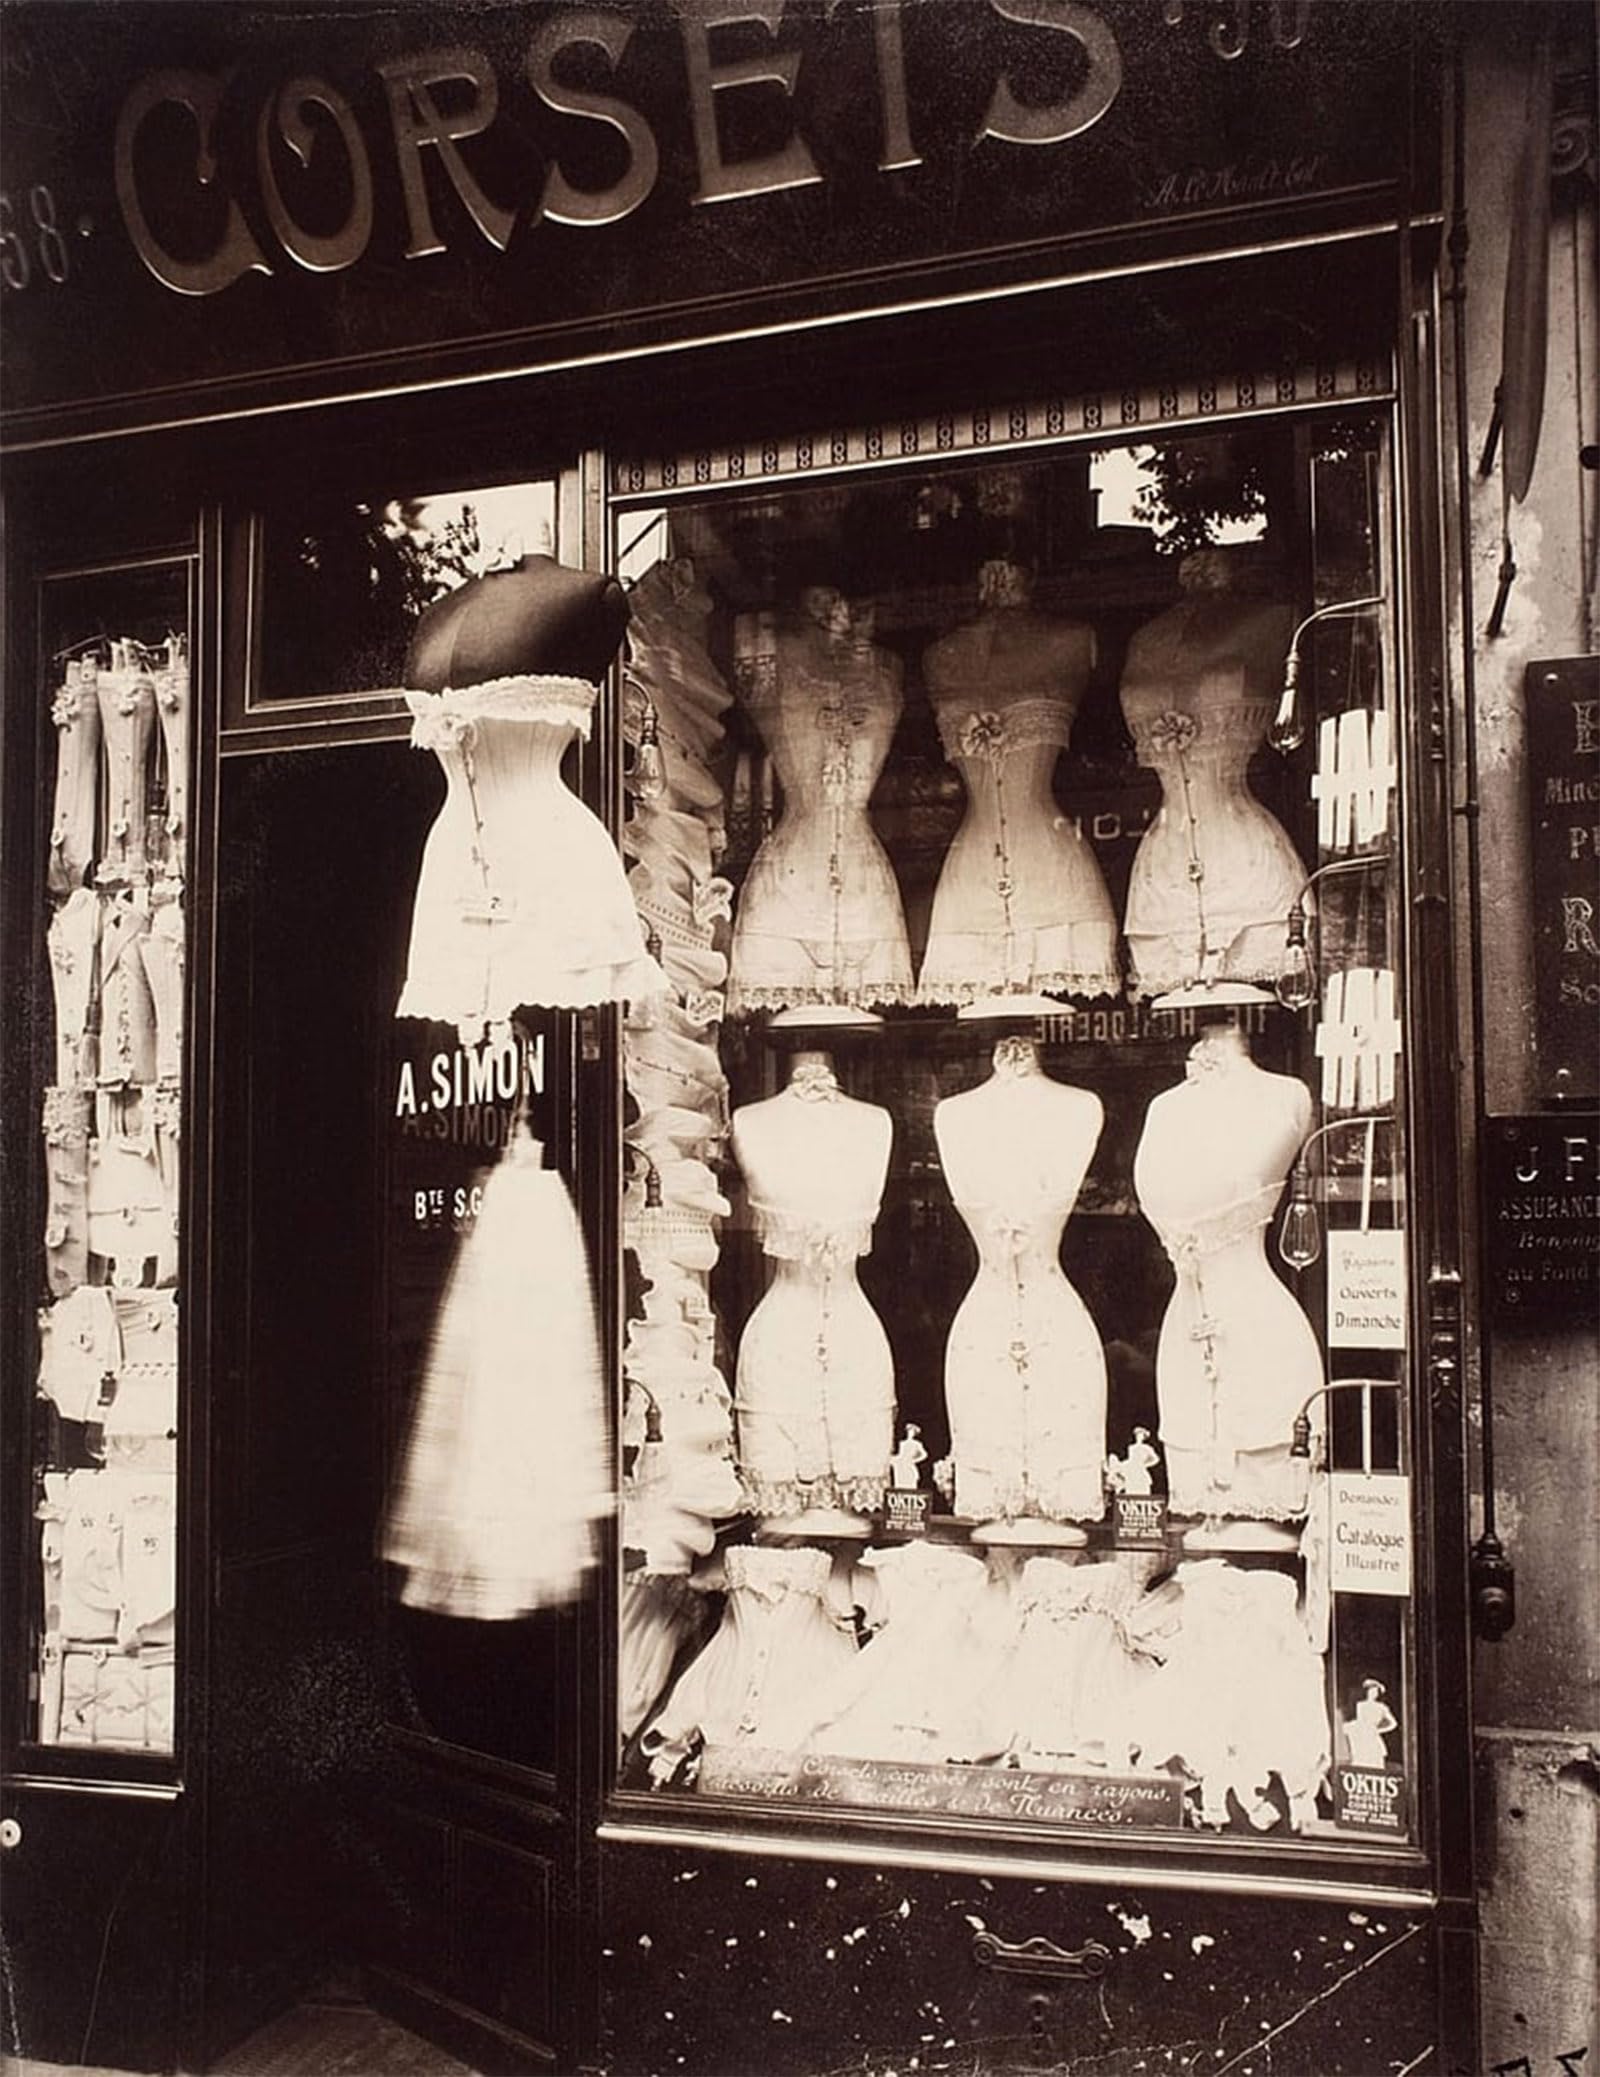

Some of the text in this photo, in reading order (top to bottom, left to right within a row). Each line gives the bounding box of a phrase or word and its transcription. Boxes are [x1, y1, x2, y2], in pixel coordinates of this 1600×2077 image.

[115, 0, 1122, 295] CORSETS
[1563, 1136, 1600, 1182] F
[1498, 1194, 1600, 1220] ASSURANC
[1335, 1311, 1401, 1330] Dimanche
[1048, 1781, 1077, 1798] en
